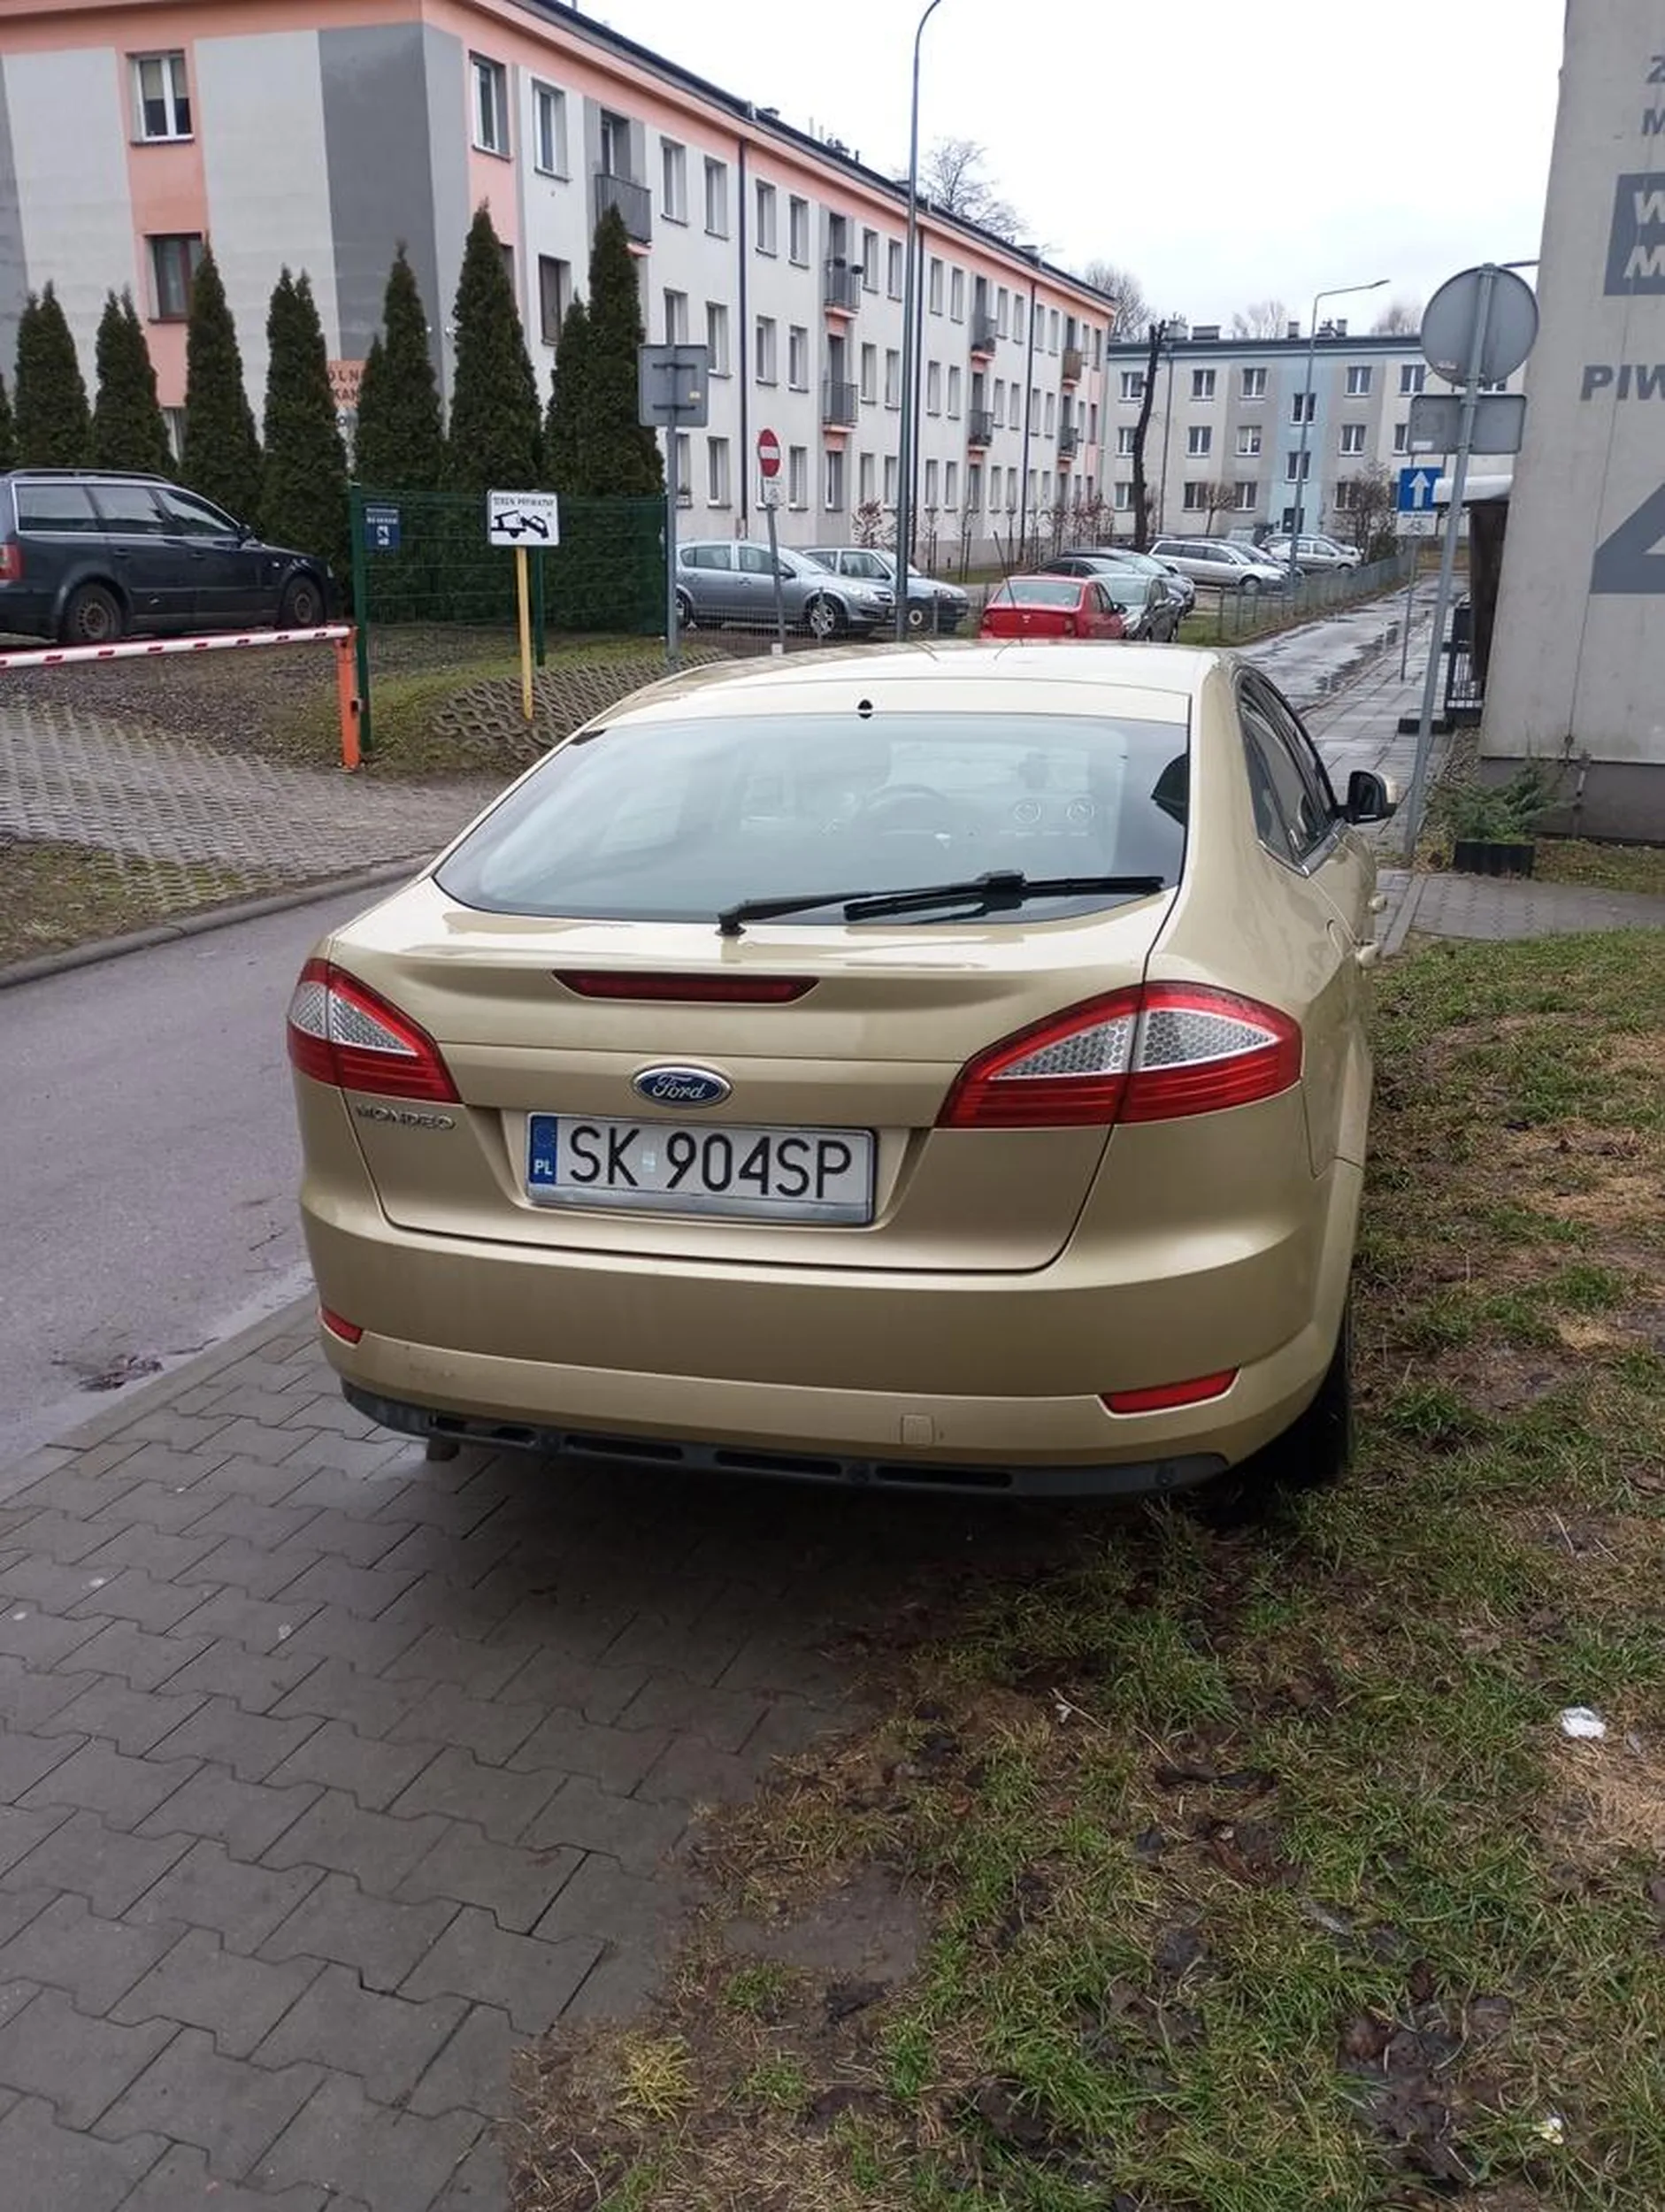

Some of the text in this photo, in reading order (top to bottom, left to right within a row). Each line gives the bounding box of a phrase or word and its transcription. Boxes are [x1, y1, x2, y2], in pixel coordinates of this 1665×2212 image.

[652, 1073, 707, 1099] Ford
[356, 1103, 457, 1131] MONDEO
[533, 1158, 554, 1176] PL
[570, 1125, 852, 1199] SK 904SP
